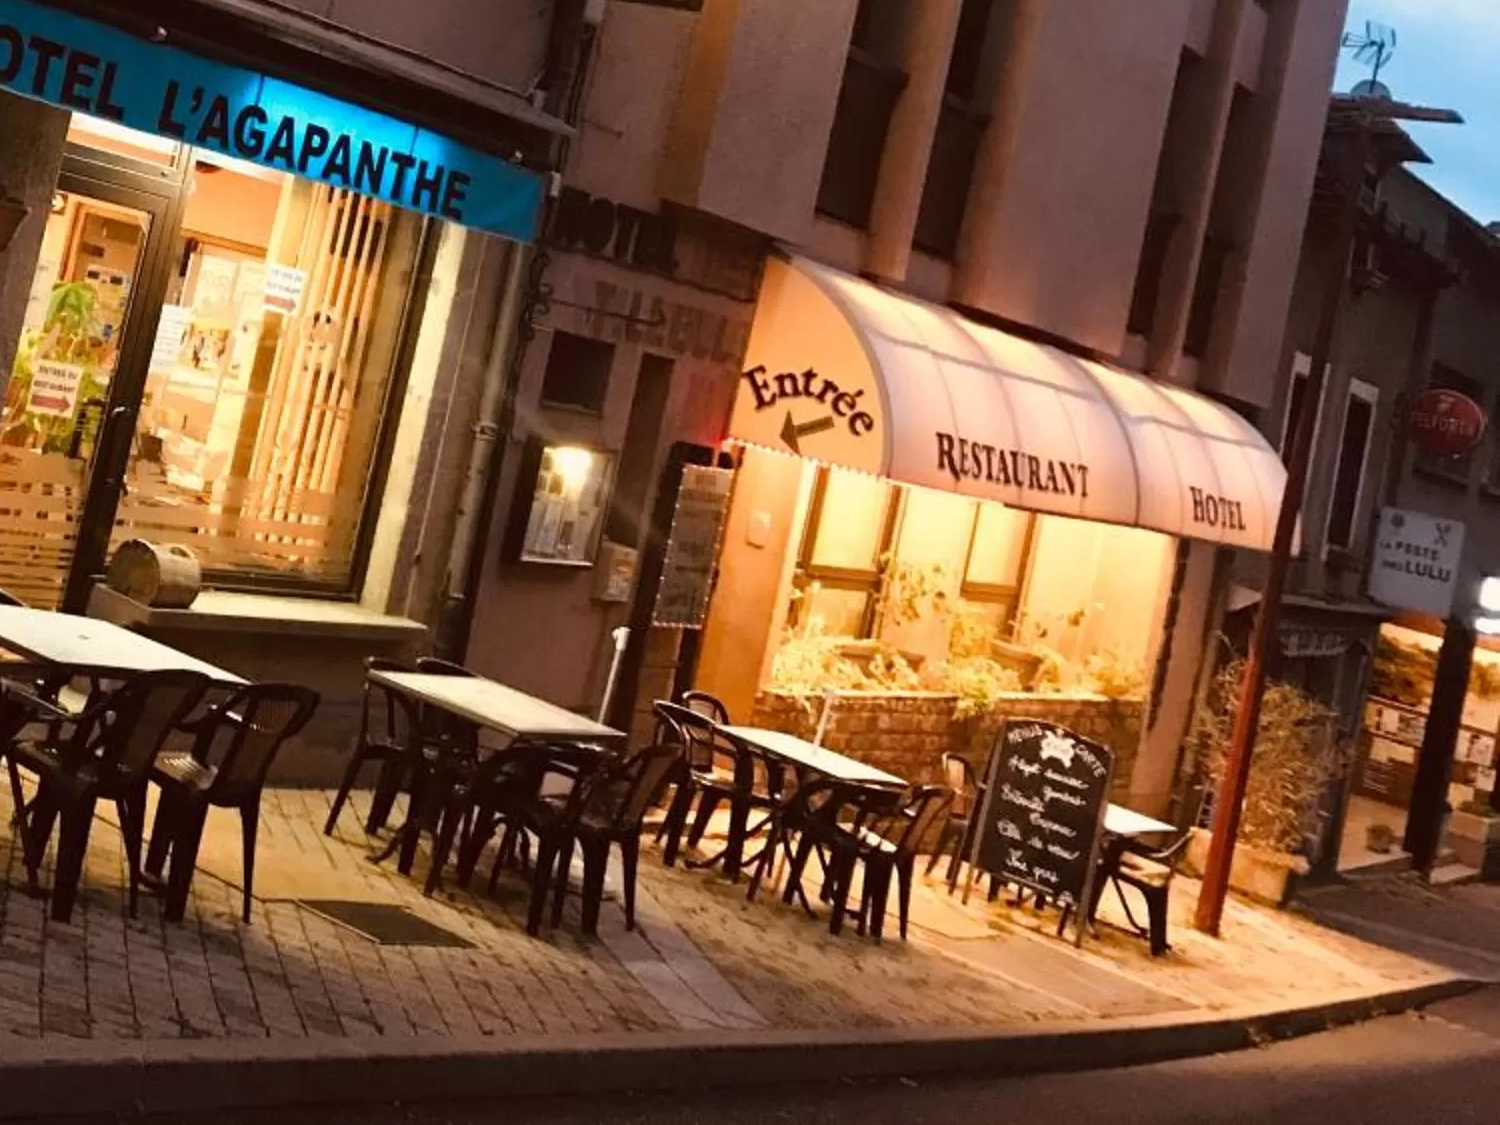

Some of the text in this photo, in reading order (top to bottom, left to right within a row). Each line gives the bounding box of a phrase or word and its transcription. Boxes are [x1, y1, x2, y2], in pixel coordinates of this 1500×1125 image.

[157, 79, 472, 219] L'AGAPANTHE
[742, 364, 874, 438] Entrée
[935, 431, 1247, 532] RESTAURANT HOTEL
[1405, 559, 1451, 583] LULU
